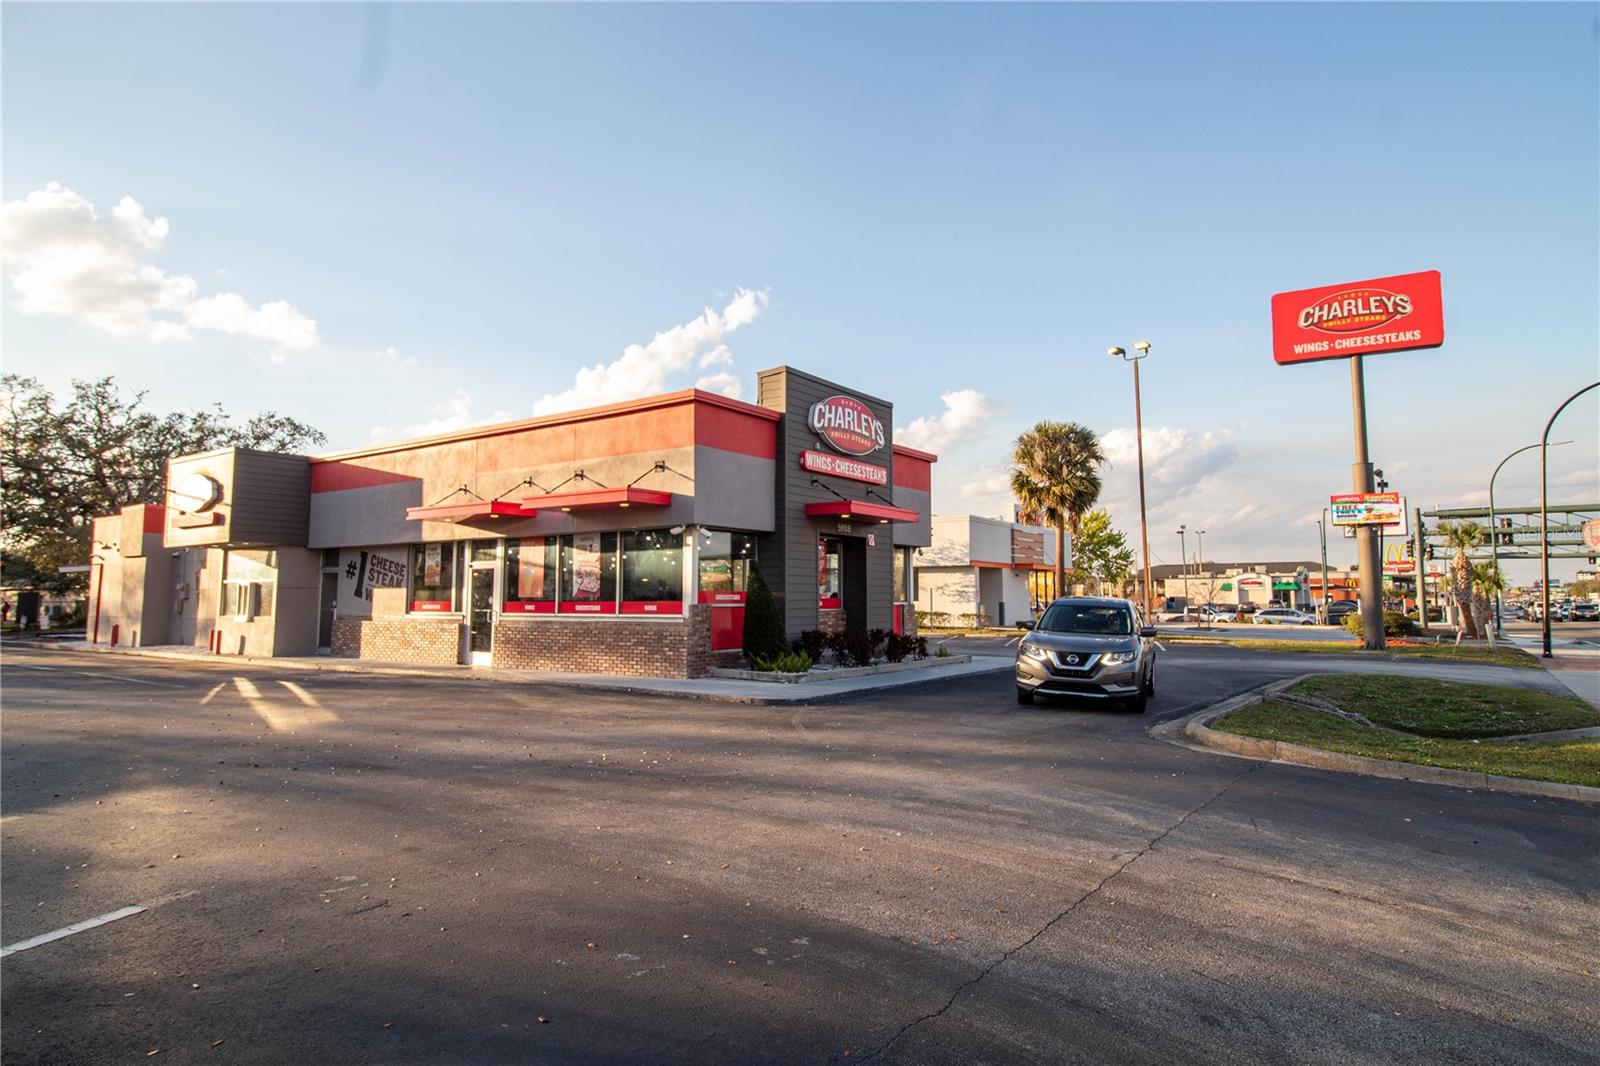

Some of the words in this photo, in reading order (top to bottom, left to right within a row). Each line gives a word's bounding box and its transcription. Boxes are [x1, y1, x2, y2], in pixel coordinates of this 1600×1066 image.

[1299, 295, 1412, 327] CHARLEYS
[1323, 319, 1351, 328] PHILLY
[1354, 315, 1387, 323] STEAKS
[1294, 341, 1329, 354] WINGS
[1334, 330, 1422, 349] CHEESESTEAKS
[813, 405, 885, 446] CHARLEYS
[831, 431, 850, 440] PHILLY
[806, 454, 832, 471] WINGS
[835, 460, 887, 482] CHEESESTEAKS
[370, 554, 406, 577] CHEESE
[368, 567, 404, 588] STEAK
